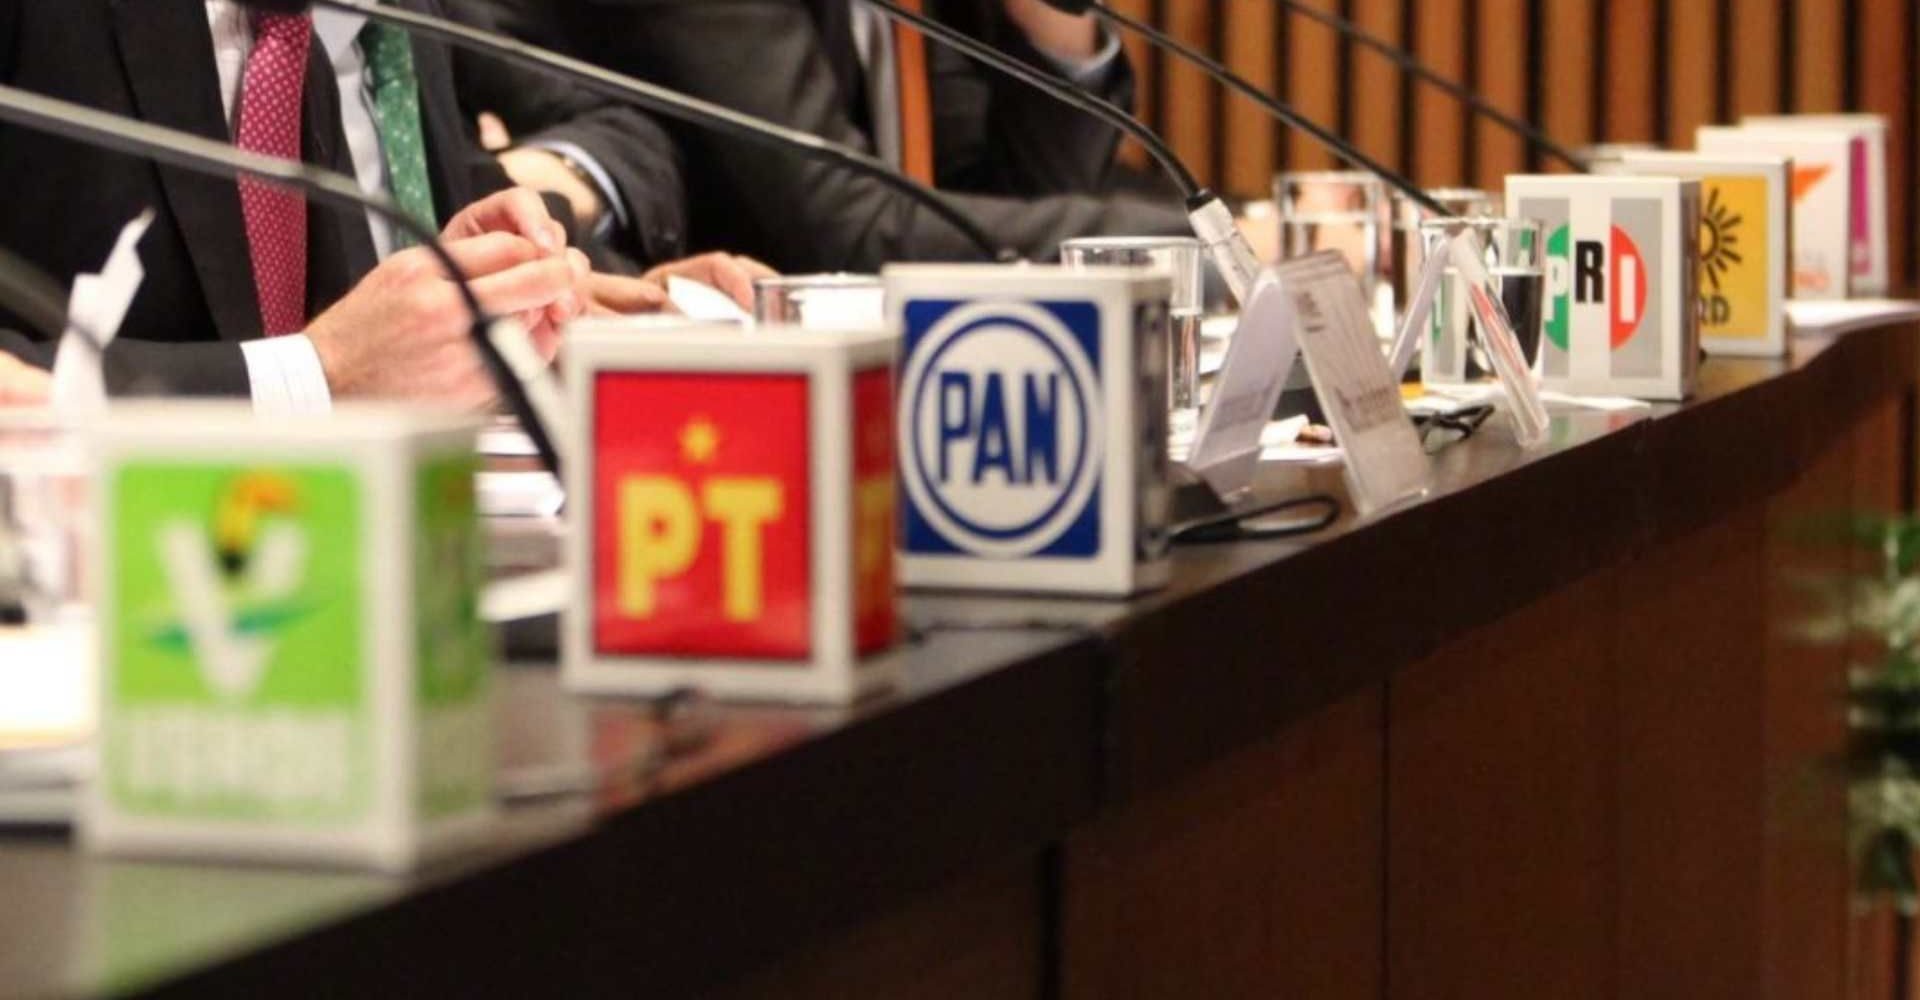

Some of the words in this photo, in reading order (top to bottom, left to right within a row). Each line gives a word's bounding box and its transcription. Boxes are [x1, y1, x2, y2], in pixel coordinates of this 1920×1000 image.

[1543, 240, 1637, 324] PRI
[939, 371, 1059, 487] PAN
[616, 476, 783, 621] PT
